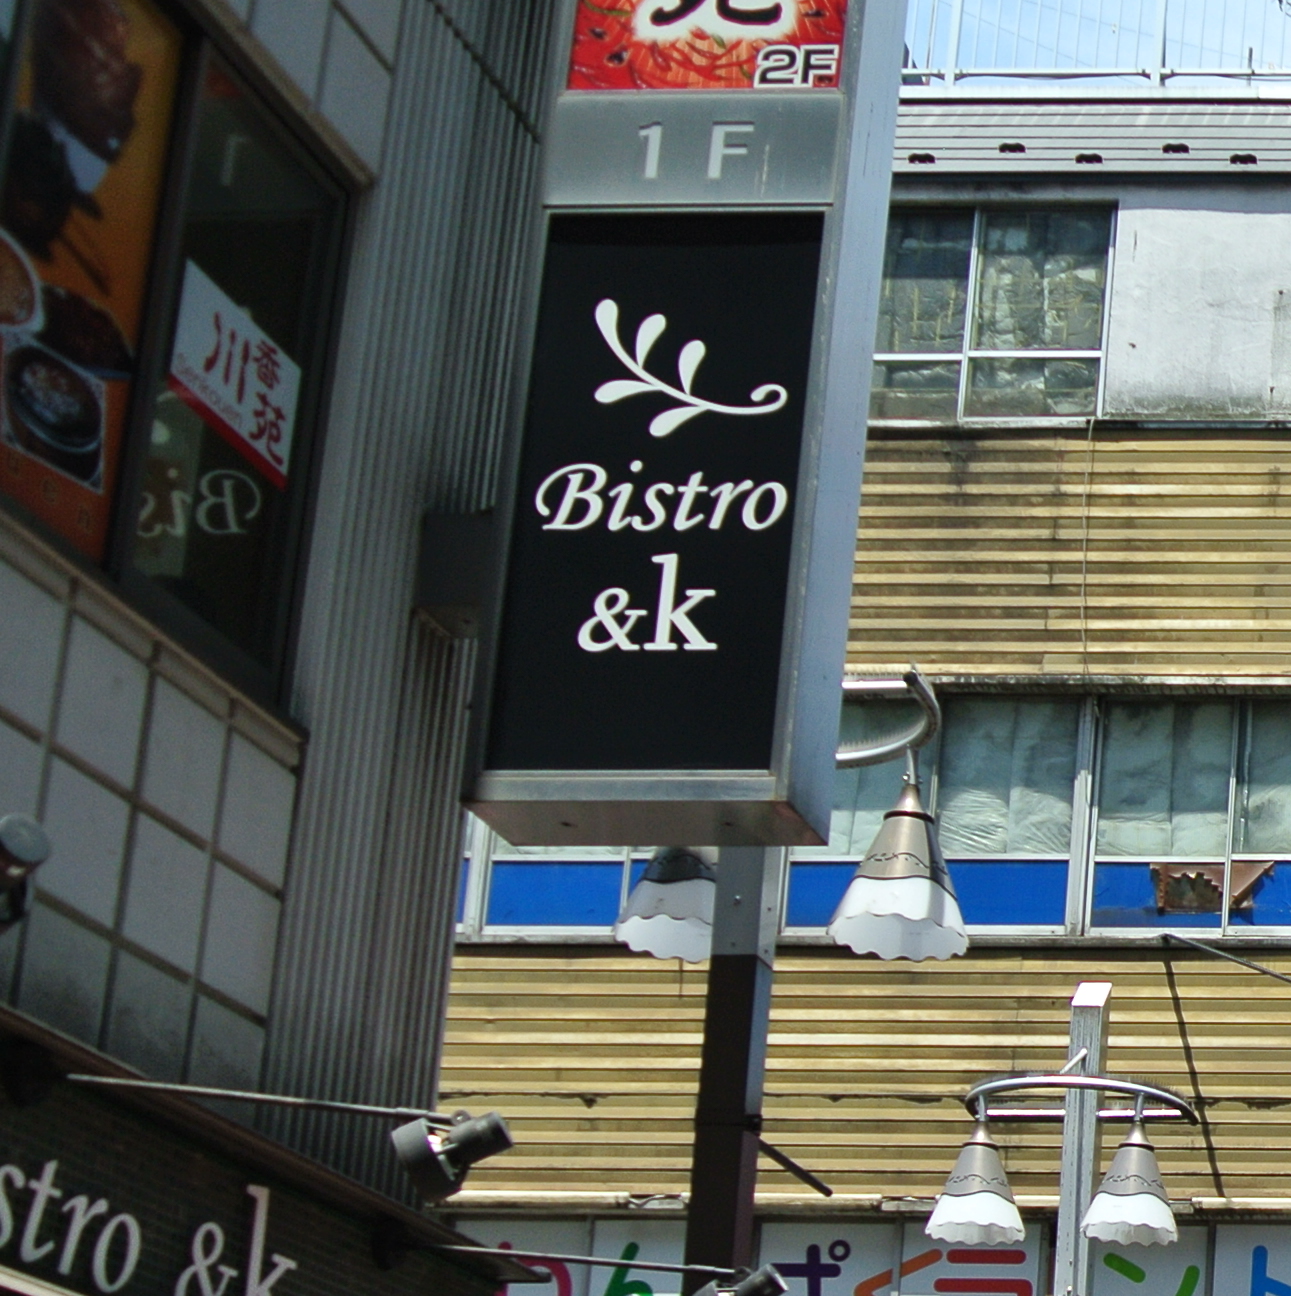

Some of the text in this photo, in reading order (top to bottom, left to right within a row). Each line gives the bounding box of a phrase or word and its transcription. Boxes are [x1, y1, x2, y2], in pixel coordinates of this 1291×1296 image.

[754, 44, 841, 87] 2F
[534, 460, 788, 533] Bistro
[576, 553, 719, 653] &k
